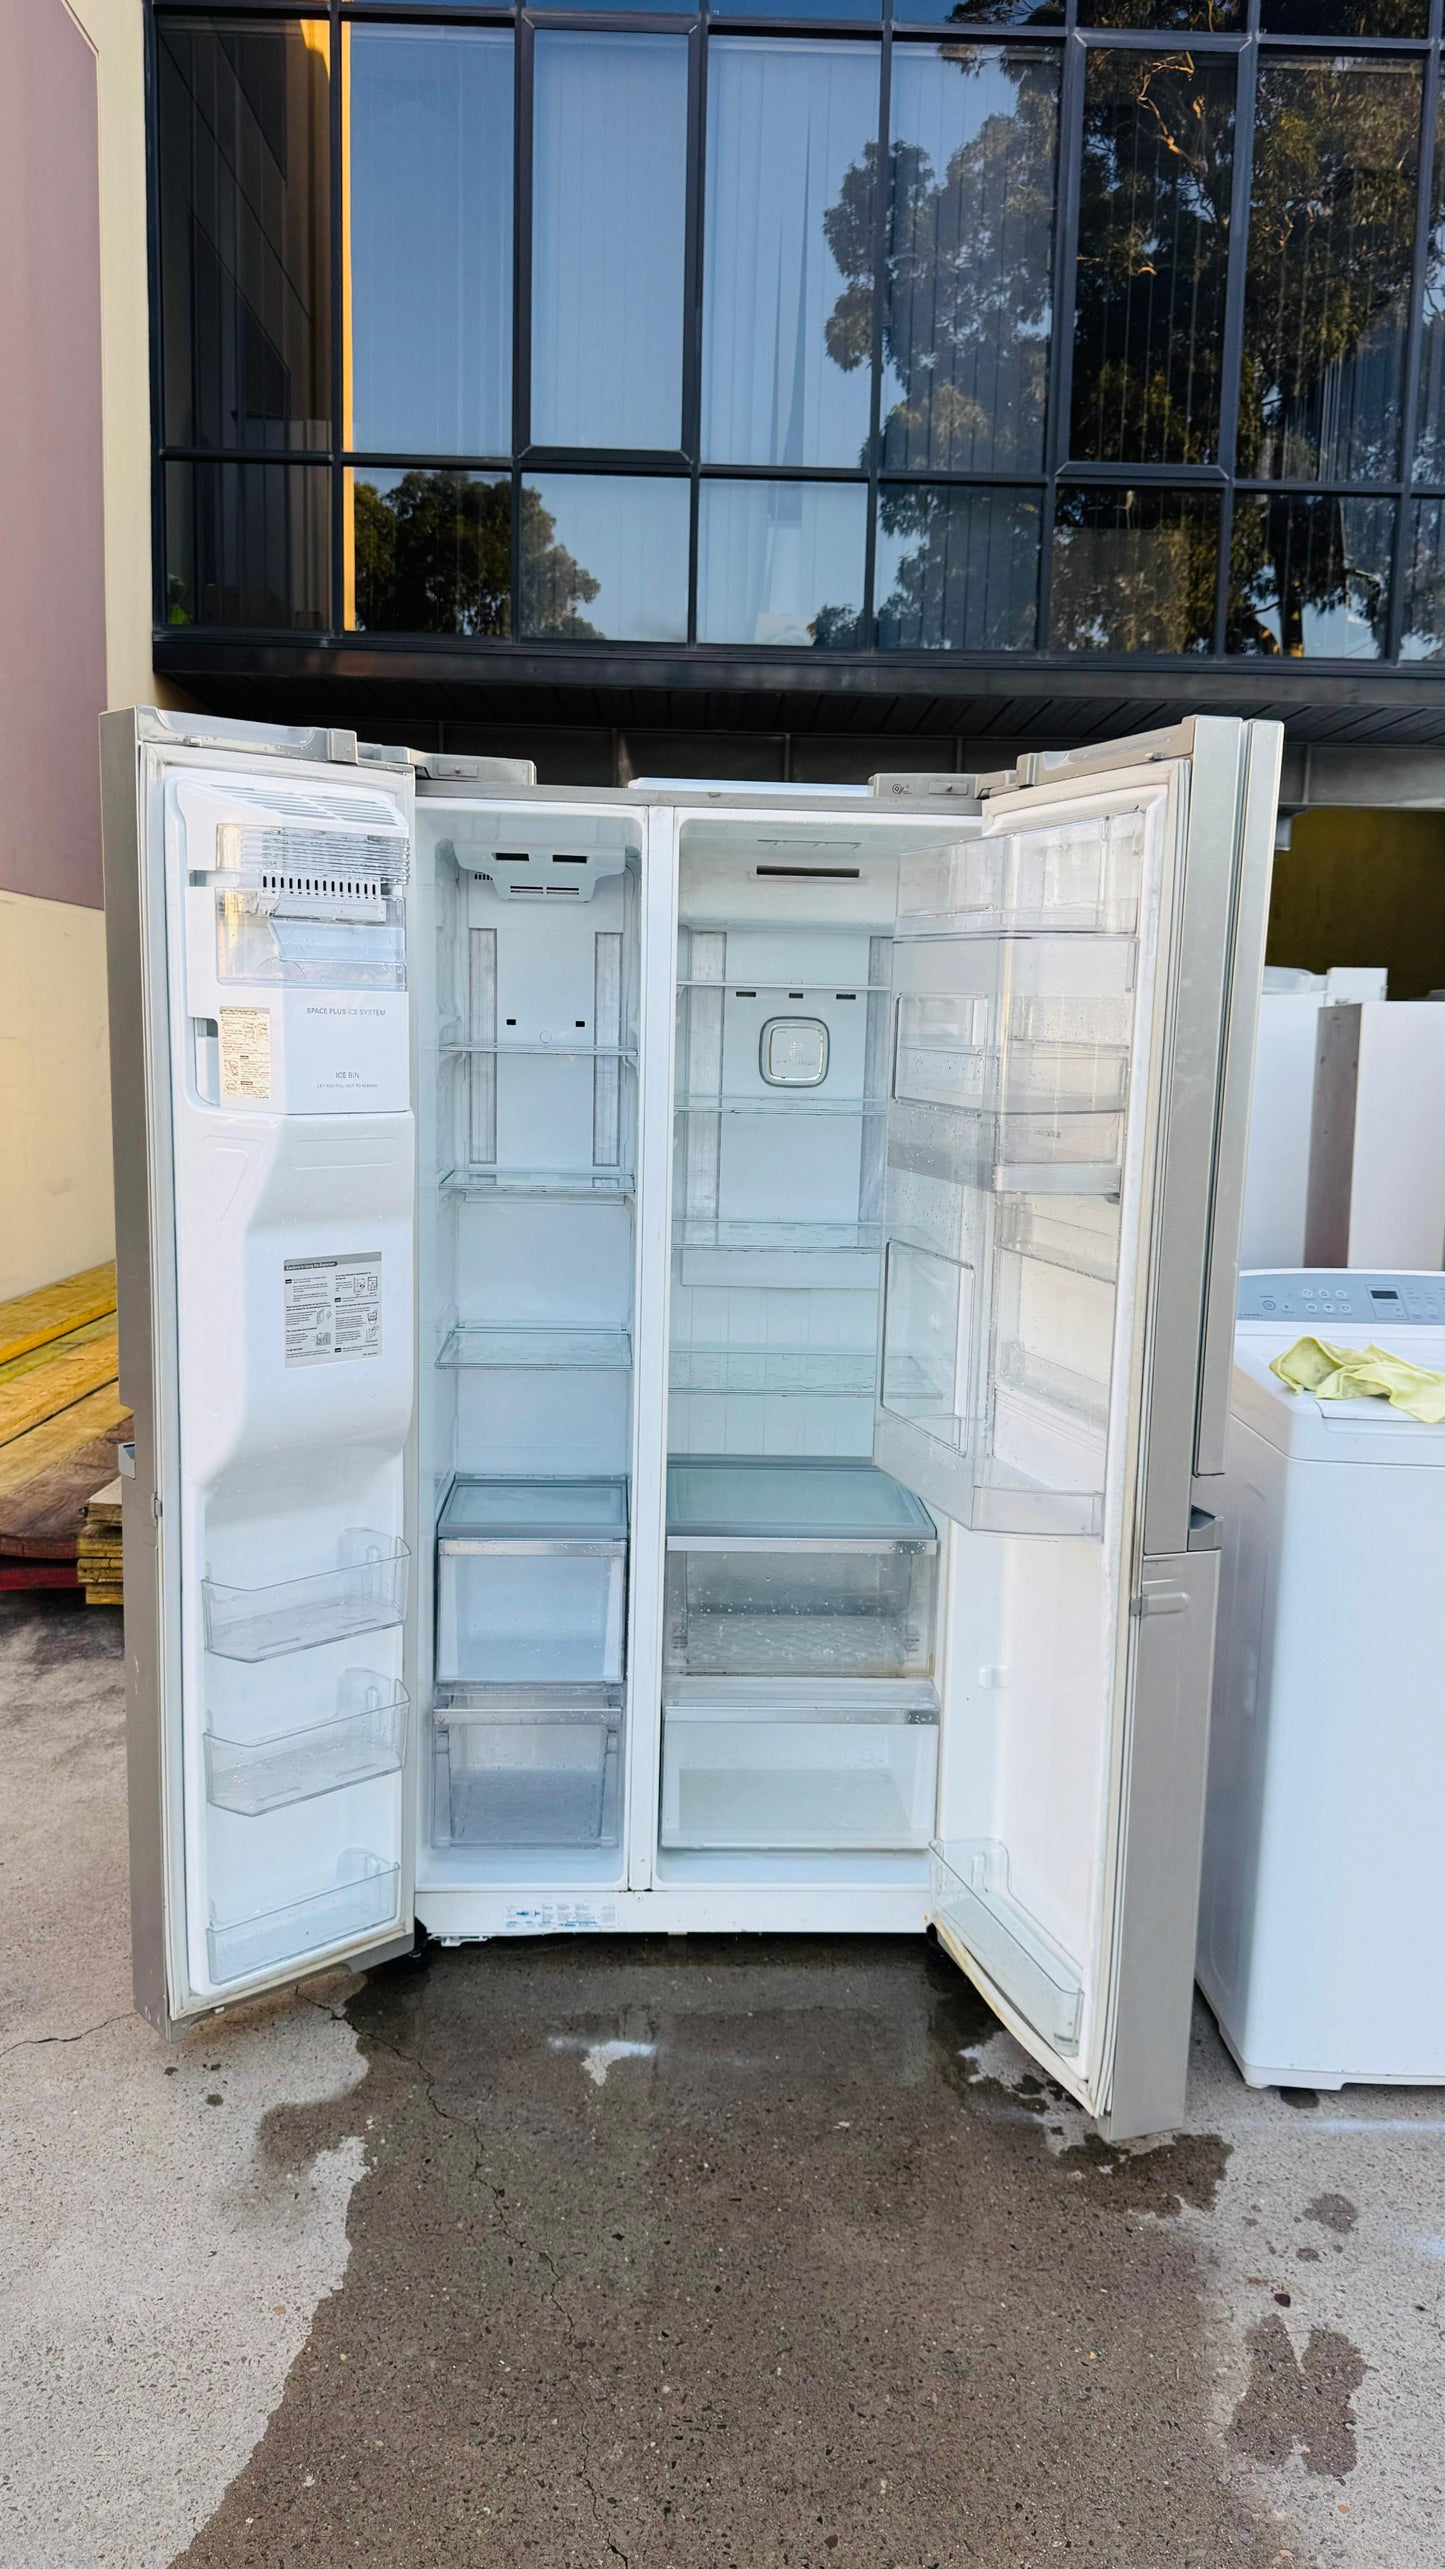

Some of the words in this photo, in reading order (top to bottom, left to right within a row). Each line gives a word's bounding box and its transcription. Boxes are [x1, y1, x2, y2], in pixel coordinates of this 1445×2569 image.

[306, 1007, 328, 1015] SPACE
[328, 1007, 347, 1016] PLUS
[347, 1008, 358, 1016] ICE
[359, 1008, 387, 1017] SYSTEM
[335, 1071, 347, 1079] ICE
[348, 1071, 360, 1079] BIN
